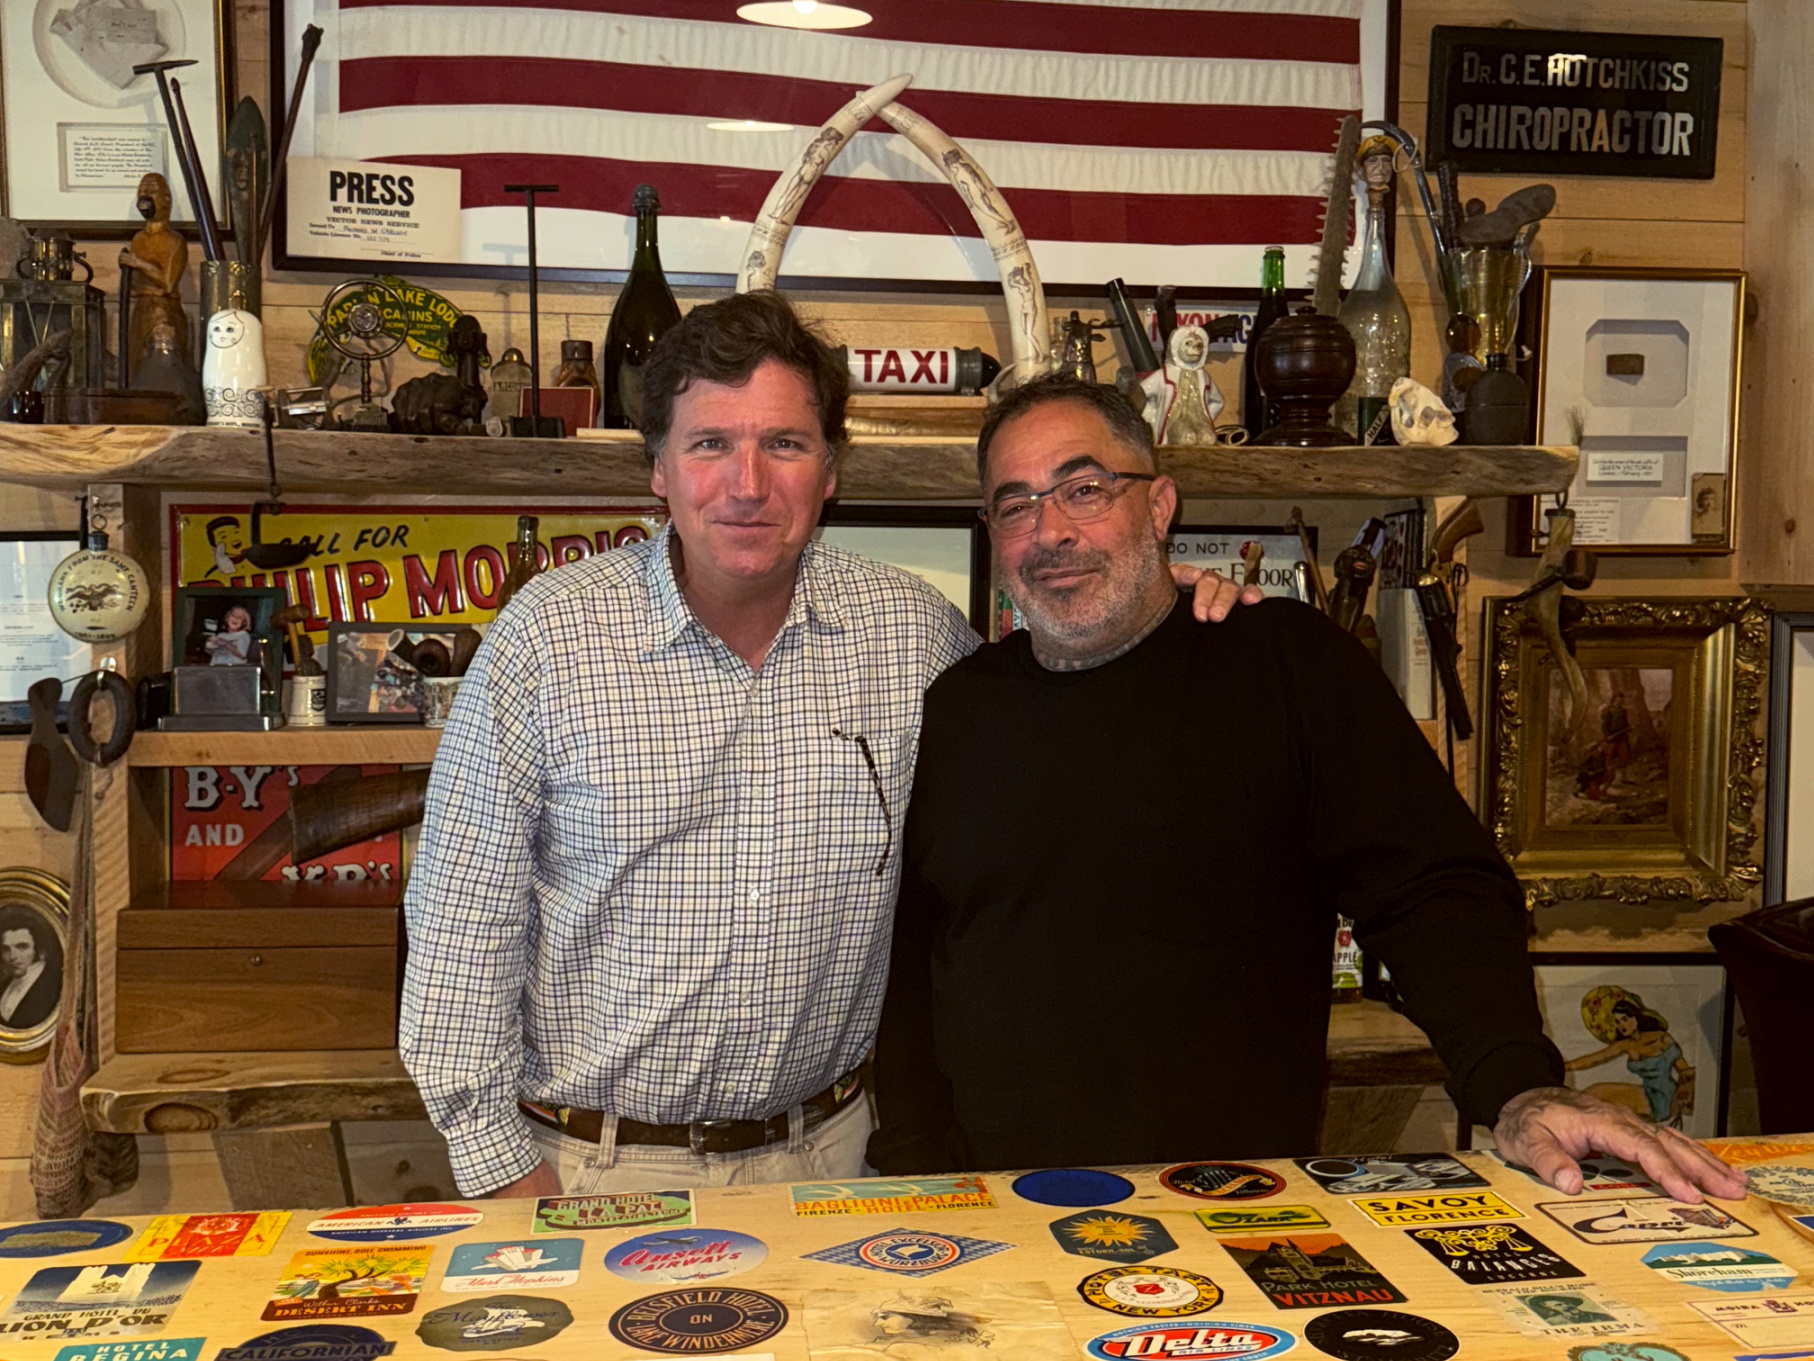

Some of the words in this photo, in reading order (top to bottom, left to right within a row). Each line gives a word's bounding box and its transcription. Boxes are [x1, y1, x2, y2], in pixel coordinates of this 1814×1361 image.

[1547, 53, 1690, 93] HOTCHKISS
[1452, 103, 1694, 156] CHIROPRACTOR
[330, 170, 415, 207] PRESS
[333, 205, 353, 214] NEWS
[356, 207, 411, 218] PHOTOGRAPHER
[360, 218, 383, 226] NEWS
[387, 220, 420, 229] SERVICE
[854, 348, 950, 385] TAXI
[353, 523, 410, 552] FOR
[1166, 542, 1188, 554] DO
[1195, 542, 1230, 555] NOT
[1230, 562, 1293, 588] FOOR
[126, 574, 139, 612] CANTEEN
[185, 823, 245, 847] AND
[556, 1197, 611, 1211] GRAND
[615, 1193, 655, 1206] HOTEL
[794, 1198, 899, 1211] BAGLIONI
[912, 1192, 990, 1206] PALACE
[796, 1207, 852, 1216] FIRENZE
[867, 1204, 922, 1214] HOTEL
[936, 1200, 996, 1209] FLORENCE
[1368, 1195, 1488, 1212] SAVOY
[315, 1220, 384, 1229] AMERICAN
[419, 1215, 481, 1224] AIRLINES
[1384, 1208, 1510, 1223] FLORENCE
[147, 1233, 267, 1248] PLAZA
[305, 1249, 351, 1257] SUNSHINE
[377, 1245, 427, 1253] SWIMMING
[619, 1240, 734, 1267] Ansett
[640, 1251, 742, 1272] AIRWAYS
[1450, 1253, 1561, 1272] BALANCES
[1085, 1268, 1139, 1296] HOTEL
[1486, 1270, 1558, 1280] LUCERNE
[1666, 1267, 1753, 1280] Shoreham
[1261, 1281, 1317, 1292] PARK
[1319, 1279, 1379, 1289] HOTEL
[626, 1291, 722, 1321] BELSFIELD
[722, 1292, 776, 1316] HOTEL
[1112, 1304, 1160, 1315] NEW
[1167, 1297, 1216, 1314] YORK
[1272, 1288, 1394, 1307] VITZNAU
[23, 1312, 72, 1321] GRAND
[274, 1305, 361, 1317] DESERT
[366, 1302, 408, 1312] INN
[1715, 1304, 1761, 1312] MOIRA
[0, 1318, 73, 1333] LION
[85, 1313, 168, 1332] D'OR
[429, 1310, 560, 1327] Mayflower
[690, 1313, 713, 1324] ON
[626, 1324, 669, 1344] LAKE
[662, 1319, 776, 1349] WINDERMERE
[1540, 1327, 1581, 1336] THE
[1591, 1323, 1645, 1332] IRMA
[97, 1341, 171, 1353] HOTEL
[224, 1343, 386, 1360] CALIFORNIAN
[1124, 1329, 1263, 1357] Delta
[69, 1349, 188, 1361] REGINA
